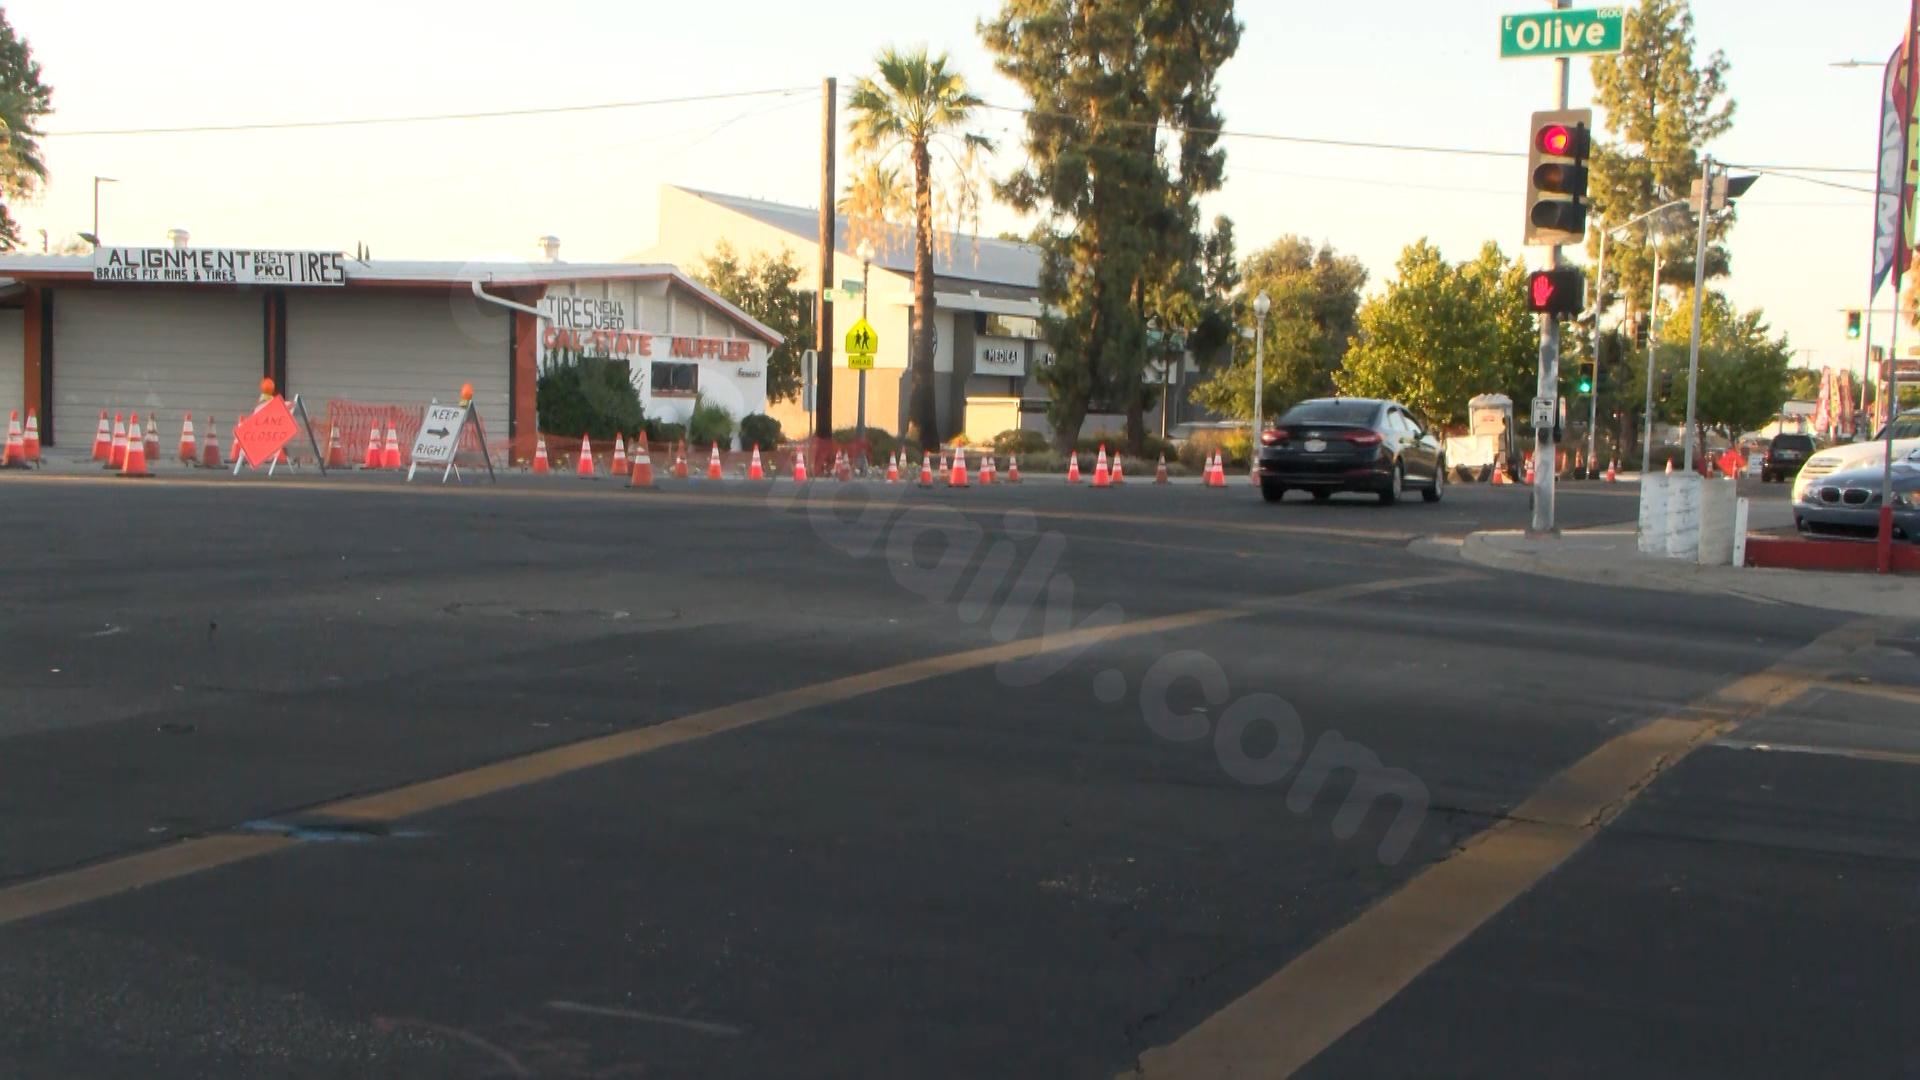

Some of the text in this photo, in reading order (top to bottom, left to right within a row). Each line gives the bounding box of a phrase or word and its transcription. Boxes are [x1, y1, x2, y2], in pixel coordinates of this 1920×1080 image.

[1597, 8, 1622, 19] 1600
[1516, 18, 1605, 50] Olive
[109, 249, 251, 270] ALIGNMENT
[254, 252, 283, 264] BEST
[254, 265, 285, 276] PRO
[284, 252, 344, 282] TIRES
[97, 267, 137, 280] BRAKES
[143, 269, 159, 280] FIX
[207, 269, 236, 281] TIRES
[546, 295, 594, 328] TIRES
[594, 315, 625, 330] USED
[543, 325, 750, 362] CAL-STATE MUFFLER
[255, 415, 286, 426] LANE
[432, 409, 459, 420] KEEP
[243, 431, 287, 441] CLOSED
[416, 443, 448, 456] RIGHT
